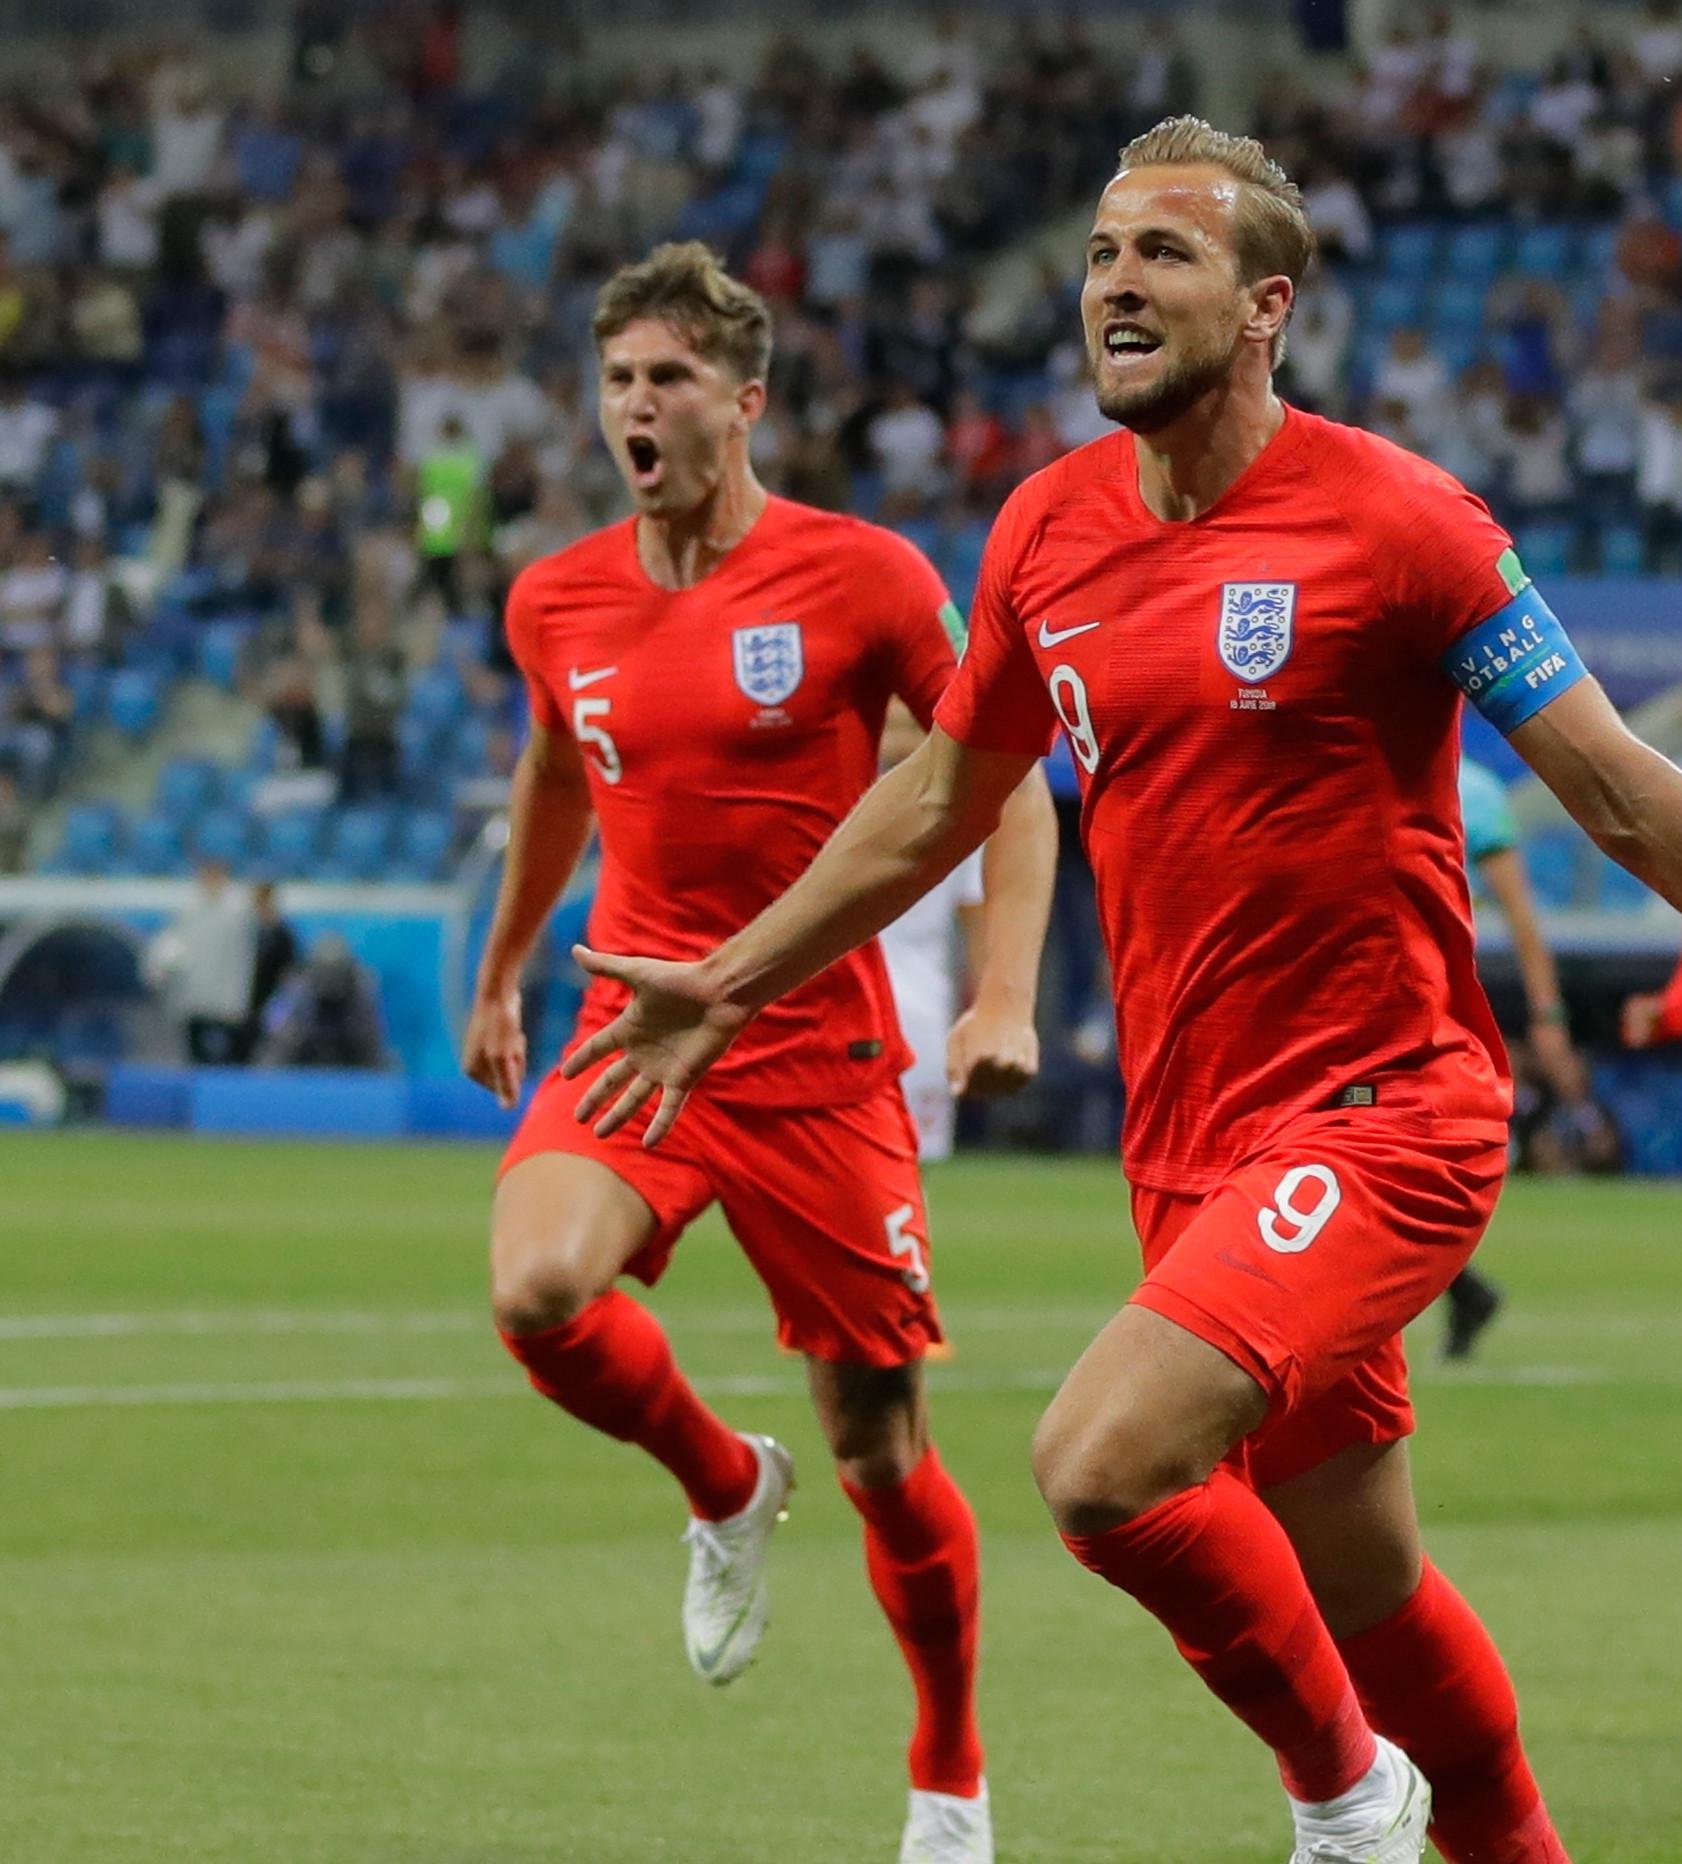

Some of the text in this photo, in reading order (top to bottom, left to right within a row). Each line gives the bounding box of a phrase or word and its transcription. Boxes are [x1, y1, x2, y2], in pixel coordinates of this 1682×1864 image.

[1524, 652, 1567, 689] FIFA
[573, 697, 622, 785] 5
[1049, 663, 1099, 774] 9
[883, 1203, 931, 1295] 5
[1257, 1163, 1342, 1253] 9
